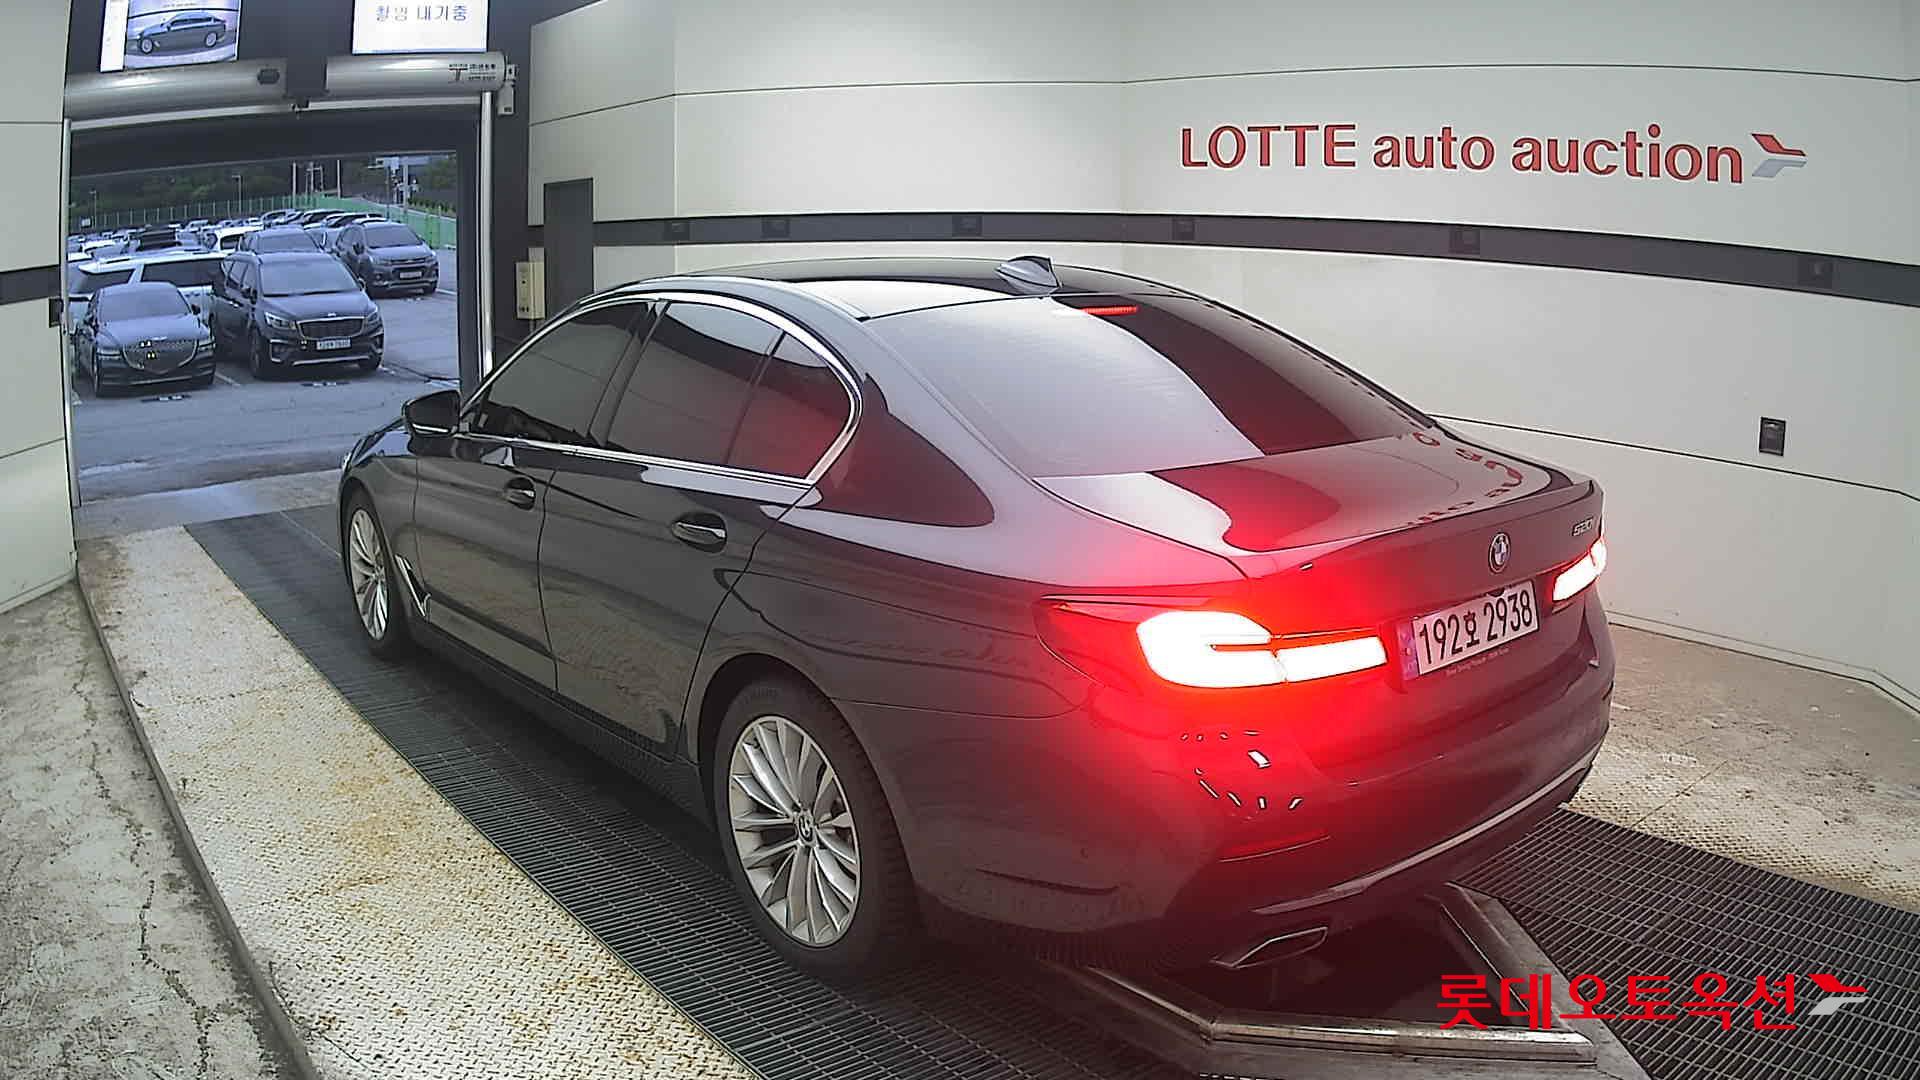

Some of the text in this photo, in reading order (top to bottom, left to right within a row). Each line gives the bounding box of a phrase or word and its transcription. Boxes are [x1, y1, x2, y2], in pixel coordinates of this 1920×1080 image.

[1181, 123, 1742, 183] LOTTE auto auction
[1483, 590, 1532, 641] 2938
